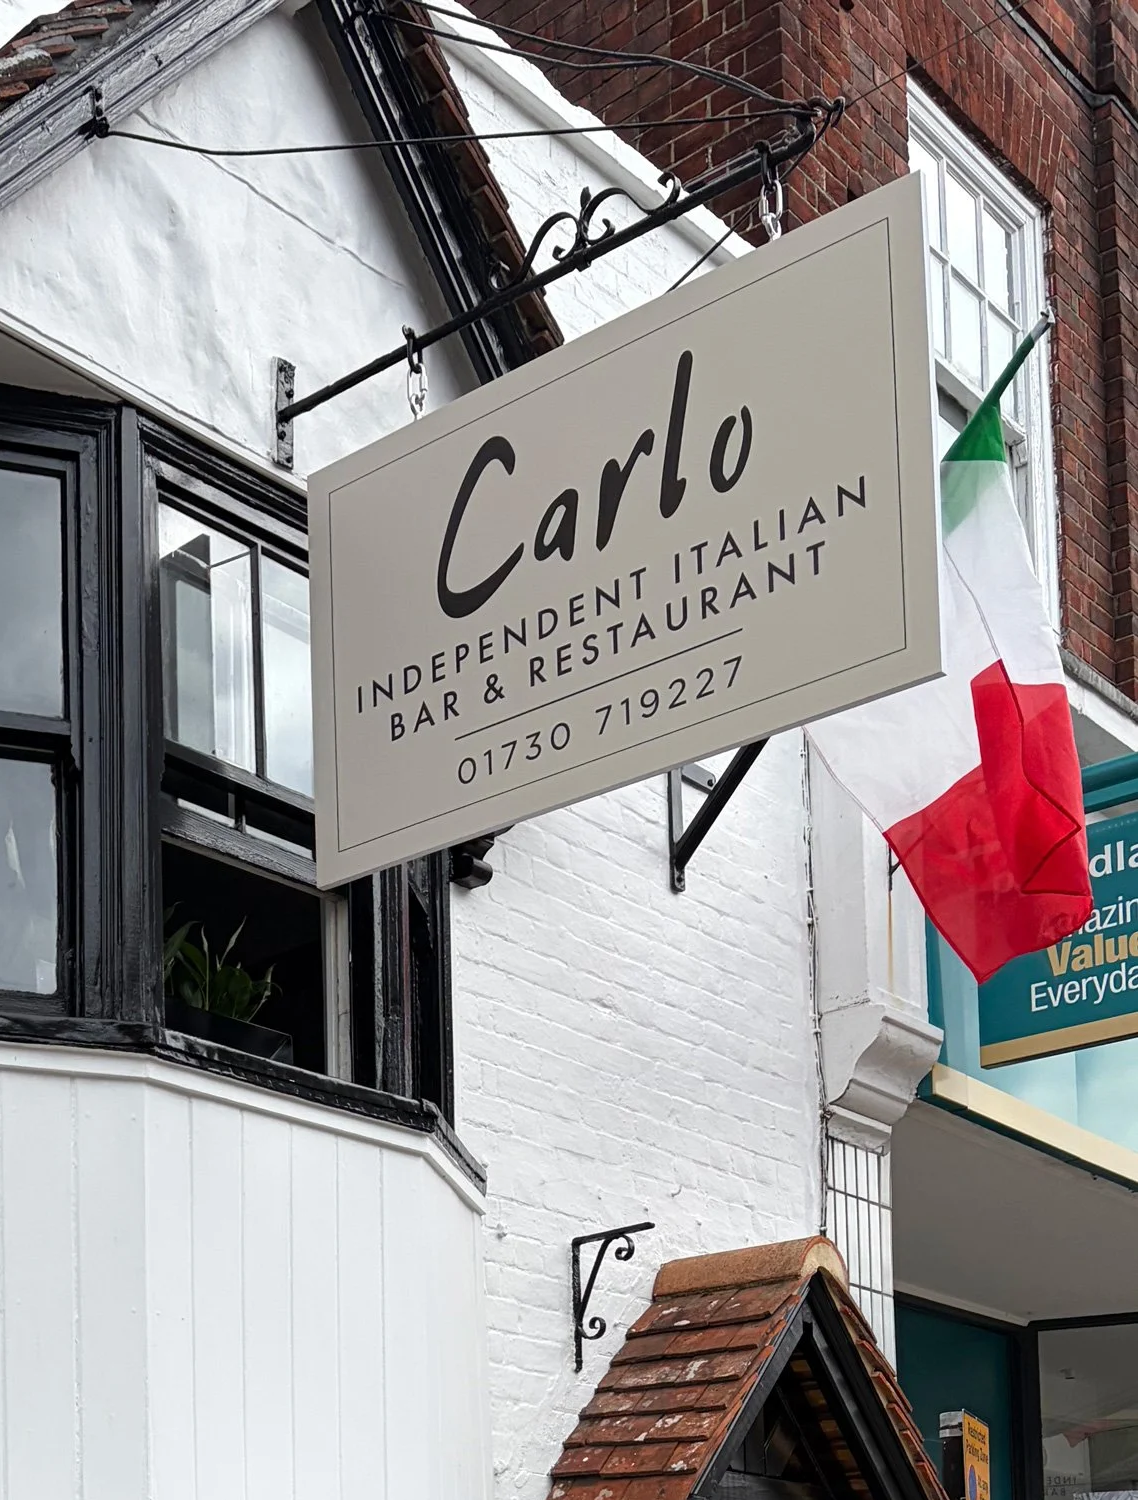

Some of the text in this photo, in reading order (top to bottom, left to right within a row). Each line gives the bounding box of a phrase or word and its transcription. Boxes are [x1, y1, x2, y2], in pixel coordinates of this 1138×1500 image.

[437, 350, 752, 618] Carlo
[357, 475, 866, 714] INDEPENDENT ITALIAN
[390, 540, 826, 742] BAR & RESTAURANT
[457, 655, 743, 785] 01730 719227
